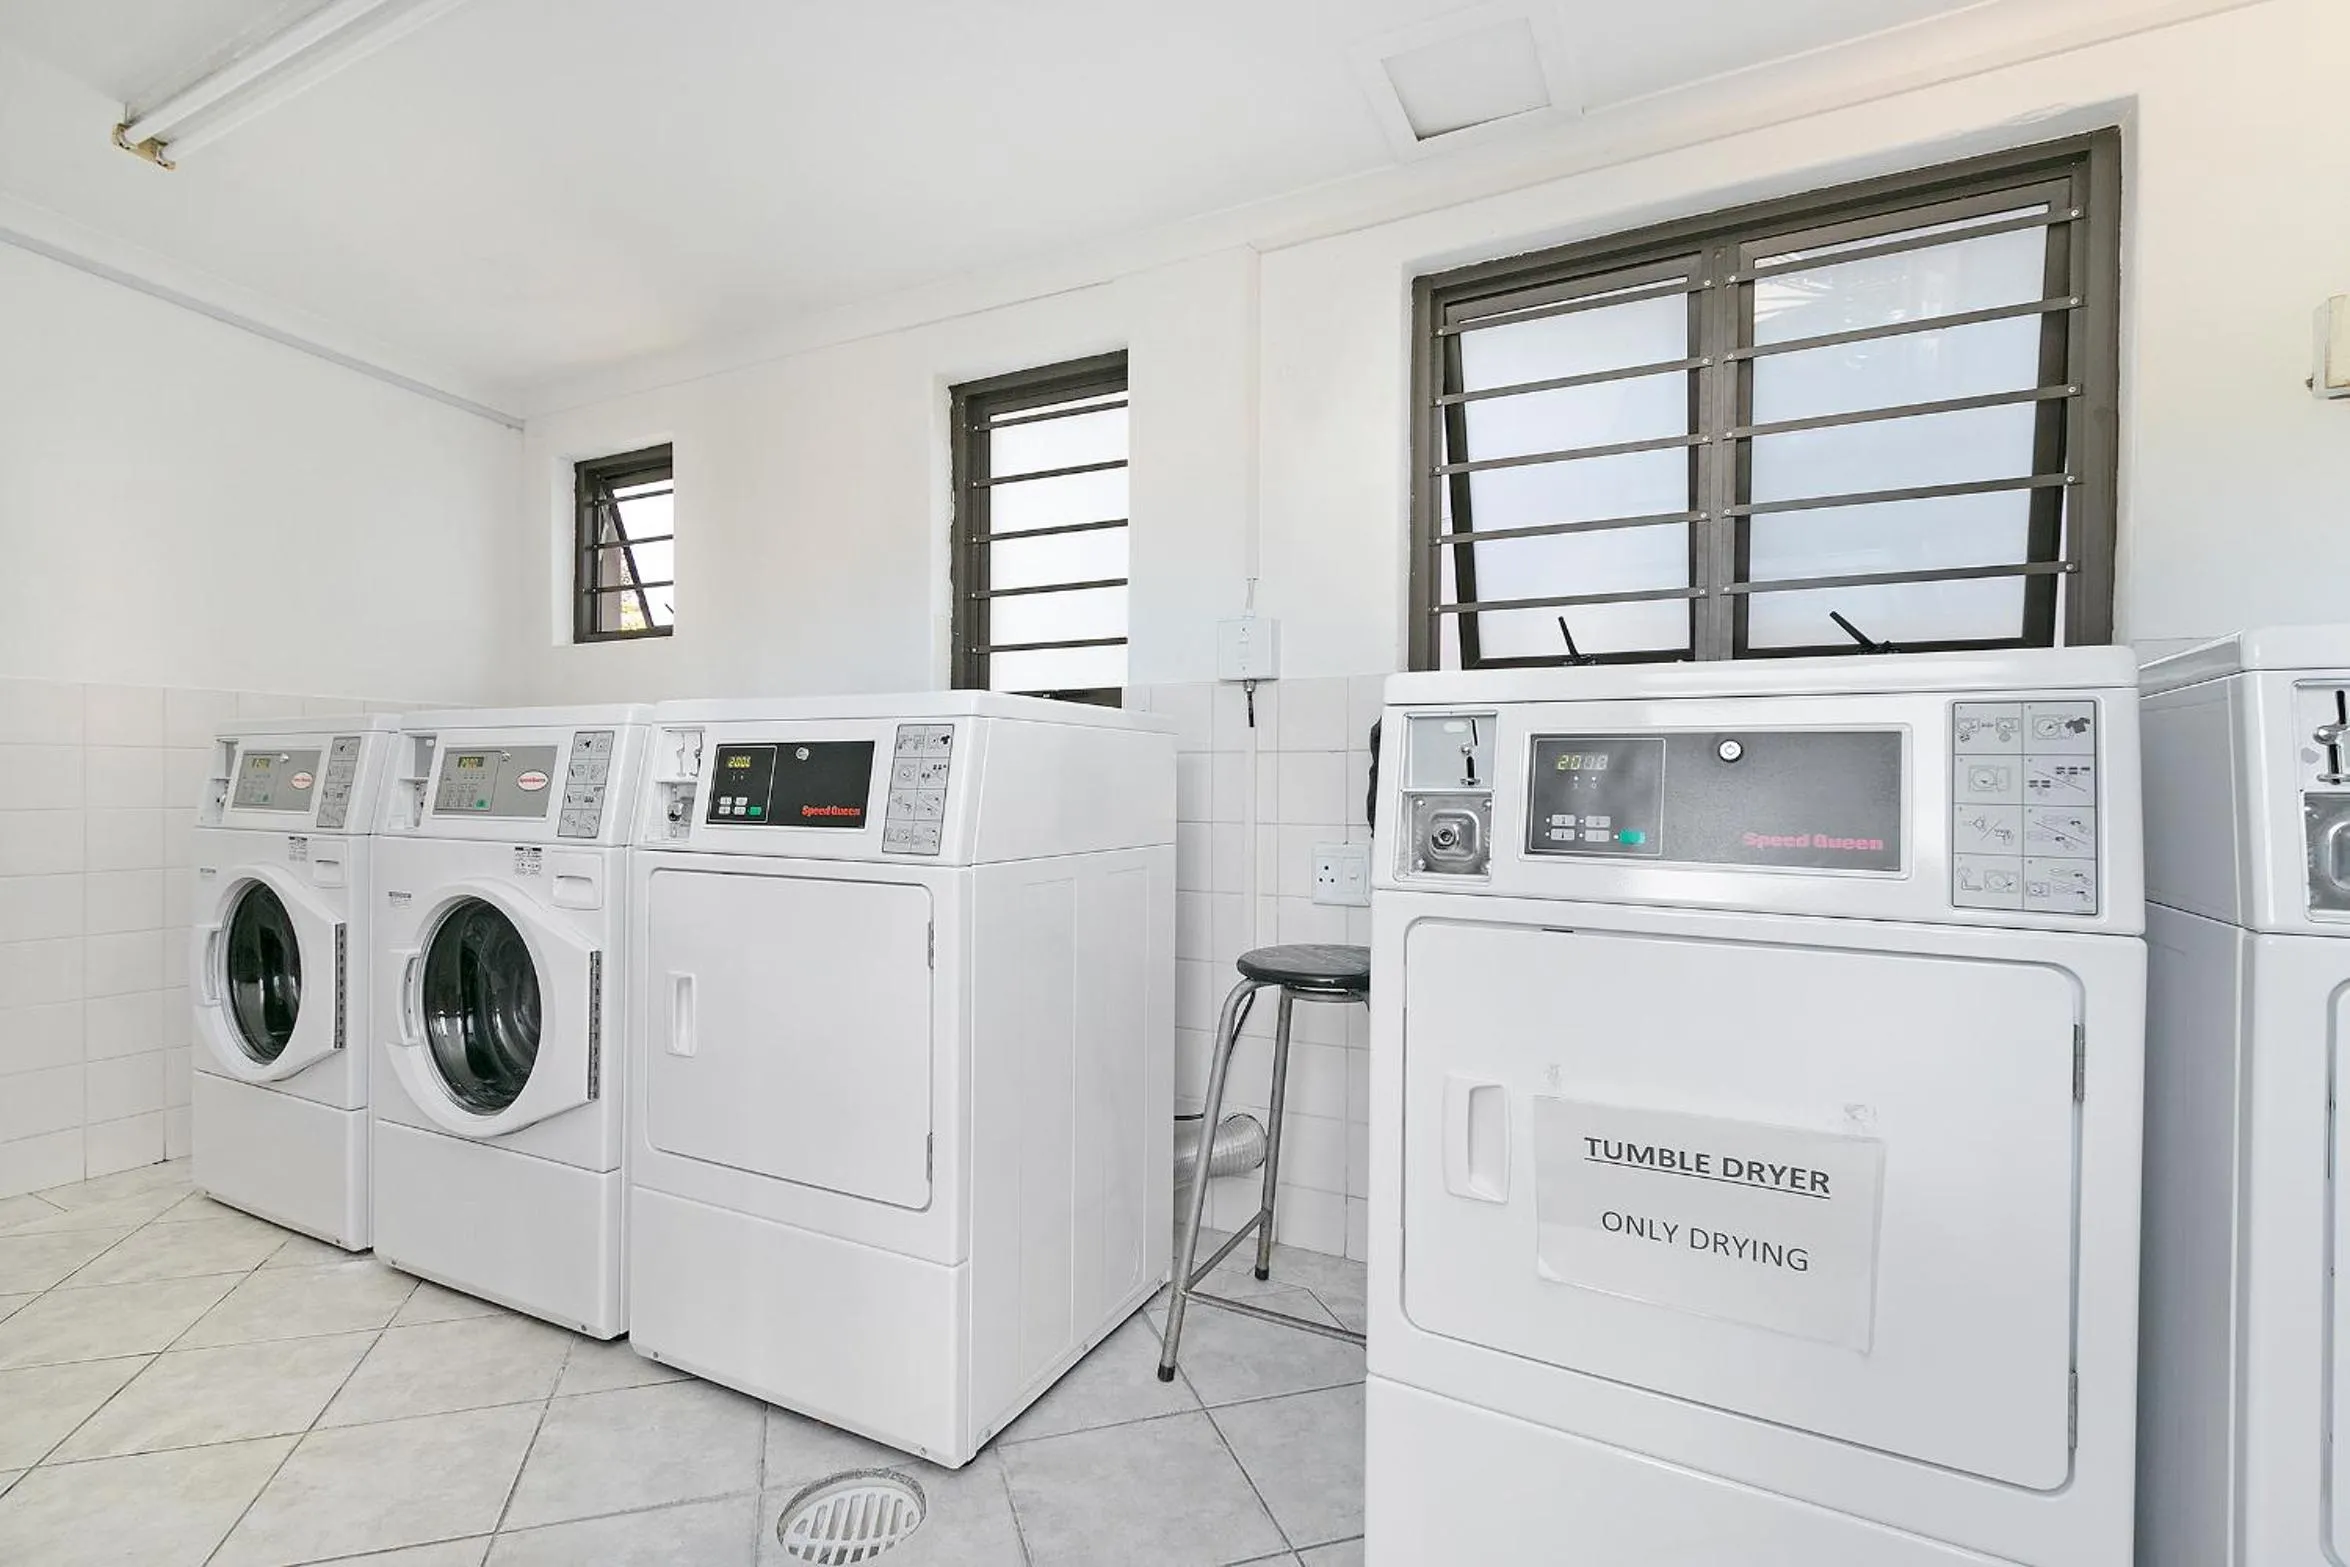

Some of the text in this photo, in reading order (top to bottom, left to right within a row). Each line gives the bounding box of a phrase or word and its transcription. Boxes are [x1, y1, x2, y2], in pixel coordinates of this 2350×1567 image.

[802, 805, 861, 816] Speed Queen
[1743, 832, 1884, 850] Speed Queen
[1584, 1137, 1831, 1195] TUMBLE DRYER
[1601, 1210, 1809, 1272] ONLY DRYING
